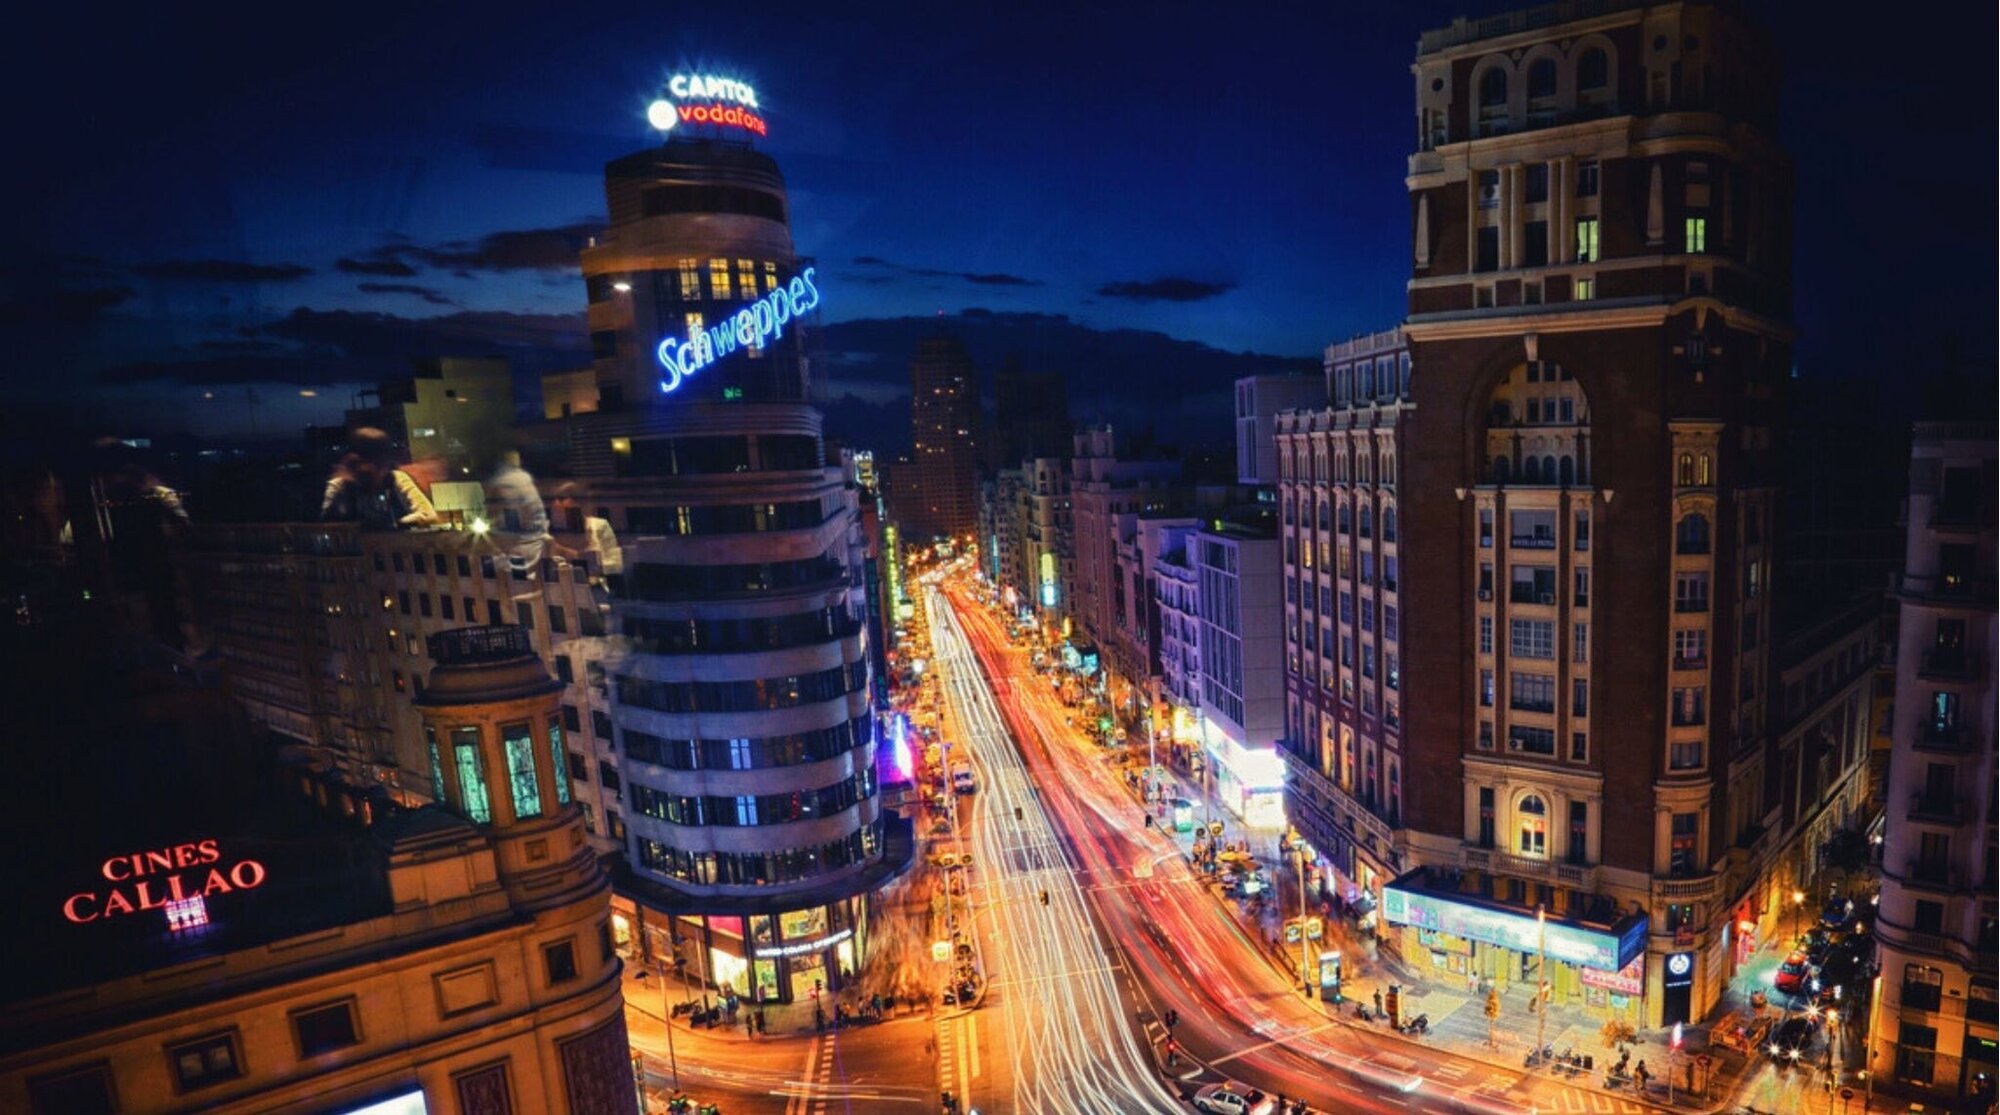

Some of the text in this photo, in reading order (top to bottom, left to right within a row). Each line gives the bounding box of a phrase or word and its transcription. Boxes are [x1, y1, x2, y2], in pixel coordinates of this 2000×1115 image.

[670, 75, 758, 108] CAPITOL
[678, 102, 767, 136] vodafone
[658, 267, 819, 393] Schweppes
[102, 840, 220, 881] CINES
[63, 860, 265, 923] CALLAO
